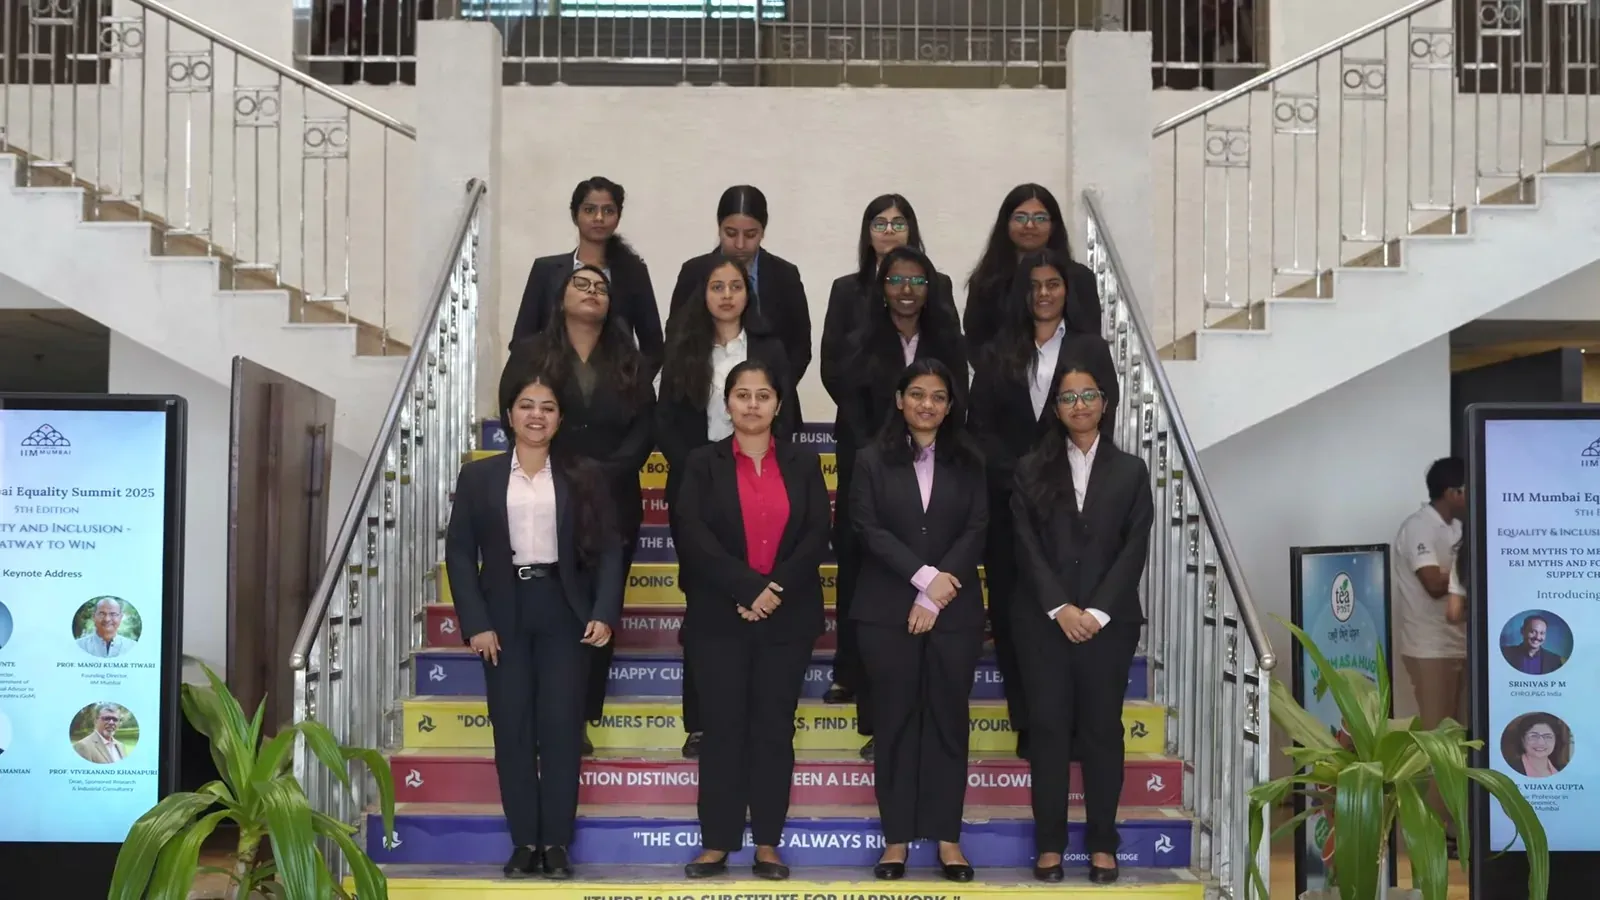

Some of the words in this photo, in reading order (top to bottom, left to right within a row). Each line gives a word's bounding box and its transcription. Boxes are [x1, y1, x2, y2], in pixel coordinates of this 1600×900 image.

[0, 486, 12, 496] ai
[16, 486, 68, 500] Equality
[72, 487, 122, 498] Summit
[125, 488, 155, 498] 2025
[1502, 492, 1524, 502] IIM
[1529, 492, 1580, 502] Mumbai
[1584, 492, 1600, 504] Eq
[14, 505, 33, 514] 5TH
[36, 505, 79, 514] EDITION
[1574, 508, 1594, 516] 5TH
[0, 524, 16, 532] TY
[19, 524, 48, 533] AND
[52, 522, 123, 534] INCLUSION
[1497, 528, 1547, 538] EQUALITY
[1550, 528, 1558, 536] &
[1560, 528, 1600, 536] INCLUSI
[0, 540, 44, 549] ATWAY
[47, 540, 65, 550] TO
[68, 540, 96, 550] WIN
[640, 537, 664, 548] THE
[1500, 548, 1529, 556] FROM
[1532, 548, 1568, 556] MYTHS
[1570, 548, 1584, 556] TO
[1586, 548, 1600, 556] ME
[2, 569, 42, 578] Keynote
[44, 569, 83, 578] Address
[1546, 570, 1584, 578] SUPPLY
[630, 576, 674, 588] DOING
[1335, 586, 1350, 604] tea
[622, 618, 656, 630] THAT
[608, 667, 657, 680] HAPPY
[804, 669, 822, 682] UR
[646, 716, 676, 728] FOR
[814, 717, 848, 730] FIND
[969, 718, 1010, 732] YOUR
[792, 772, 822, 786] EEN
[826, 772, 839, 786] A
[842, 772, 875, 786] LEA
[633, 832, 671, 846] "THE
[788, 834, 861, 849] ALWAYS
[1116, 853, 1139, 861] RIDGE
